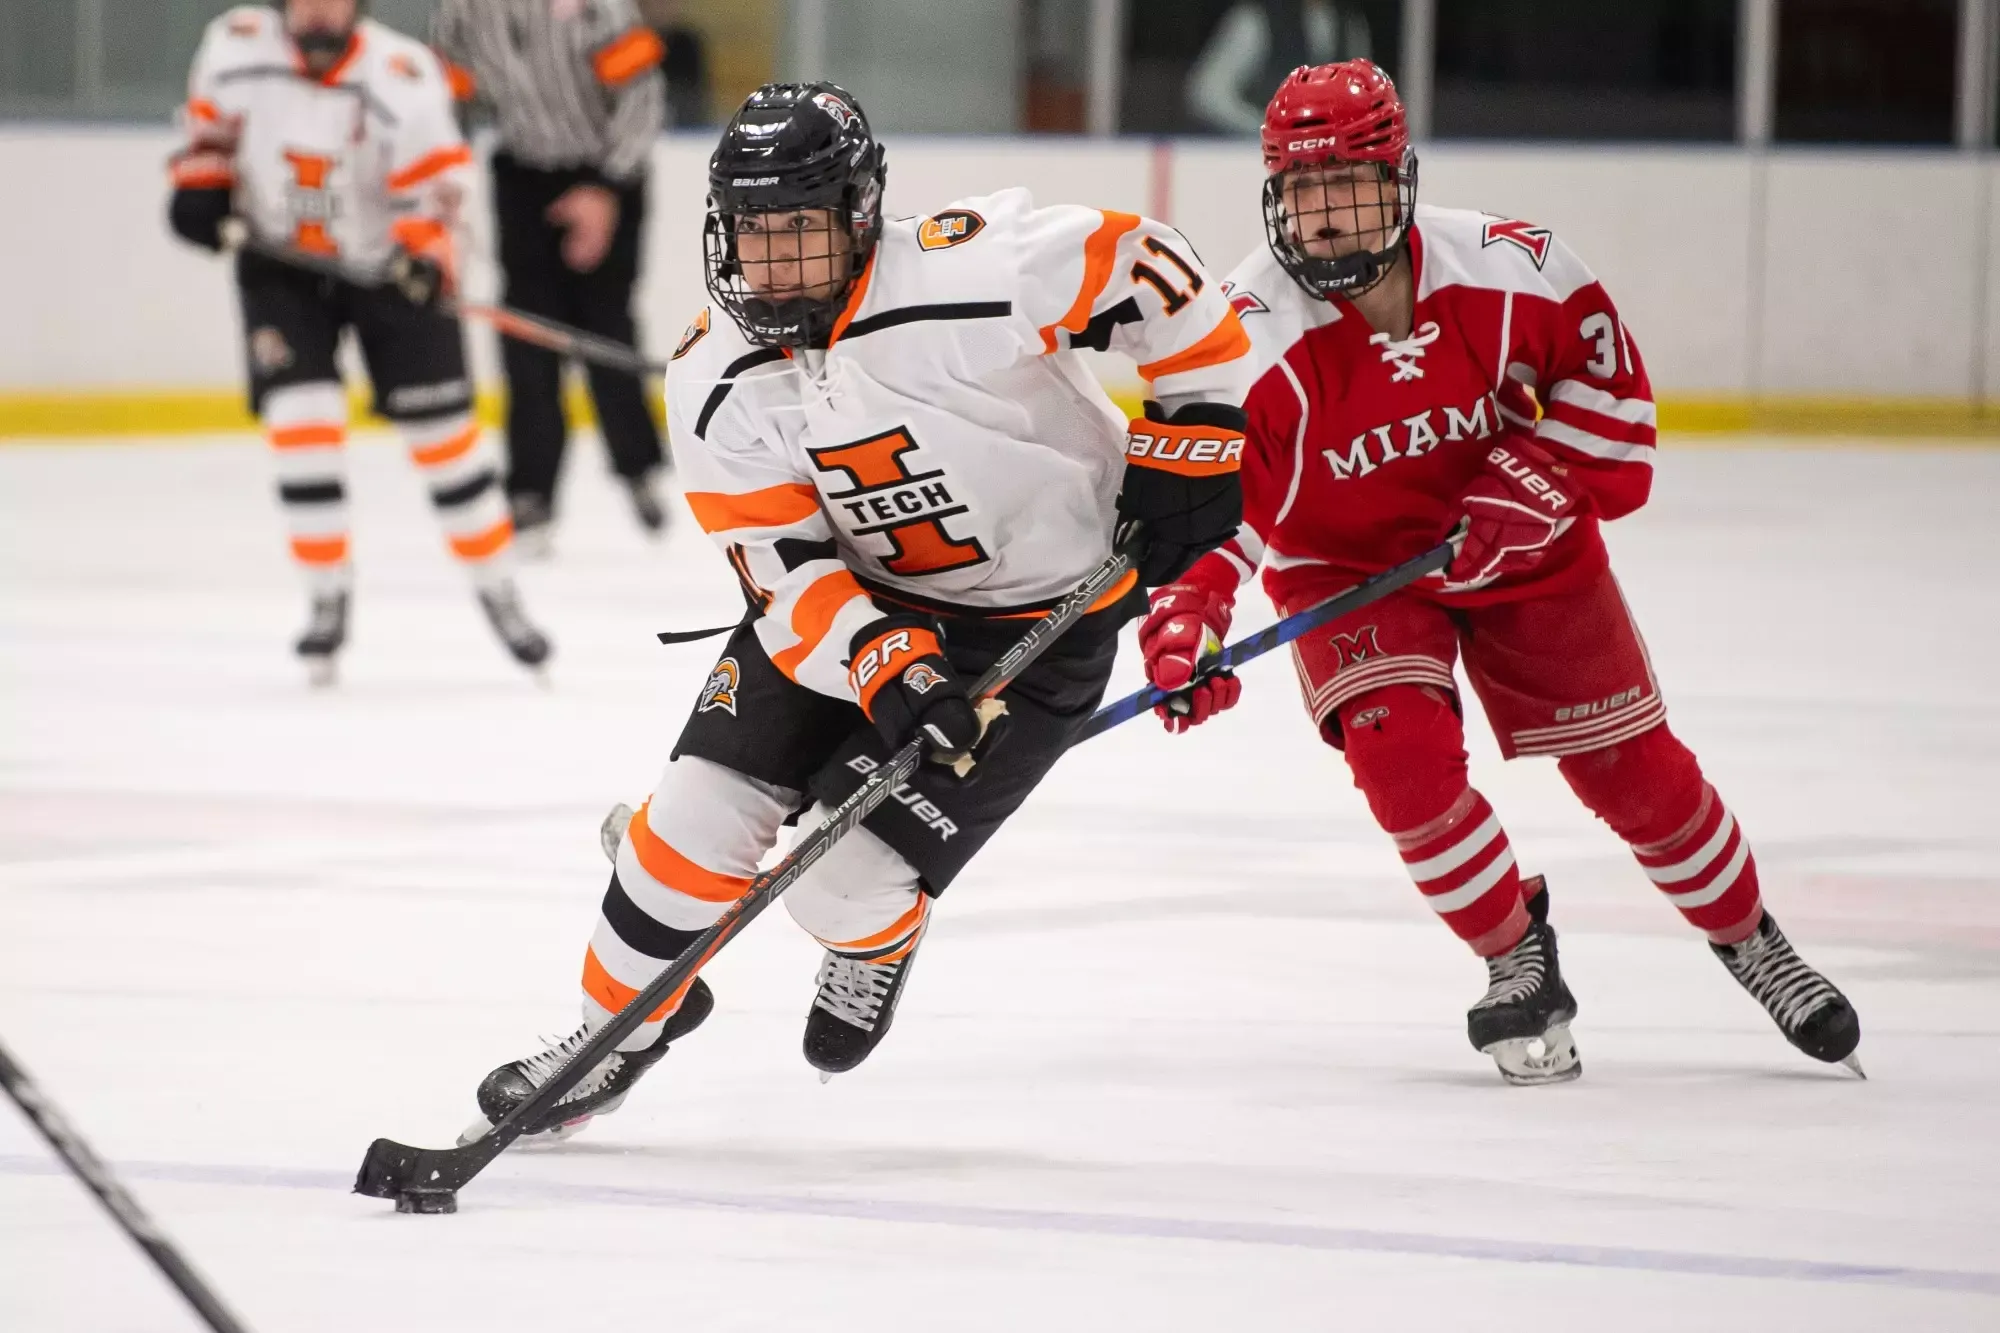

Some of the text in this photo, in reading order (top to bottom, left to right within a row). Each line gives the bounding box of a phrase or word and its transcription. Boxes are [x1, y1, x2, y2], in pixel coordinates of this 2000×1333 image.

[1288, 136, 1336, 151] CCM
[732, 176, 780, 187] BAUER
[1131, 235, 1205, 317] 11
[1318, 274, 1357, 288] CCM
[754, 324, 800, 335] CCM
[1125, 432, 1246, 463] AUER
[842, 482, 954, 525] TECH
[852, 631, 912, 698] ER
[1554, 684, 1641, 722] BAUER
[845, 755, 959, 842] BUER
